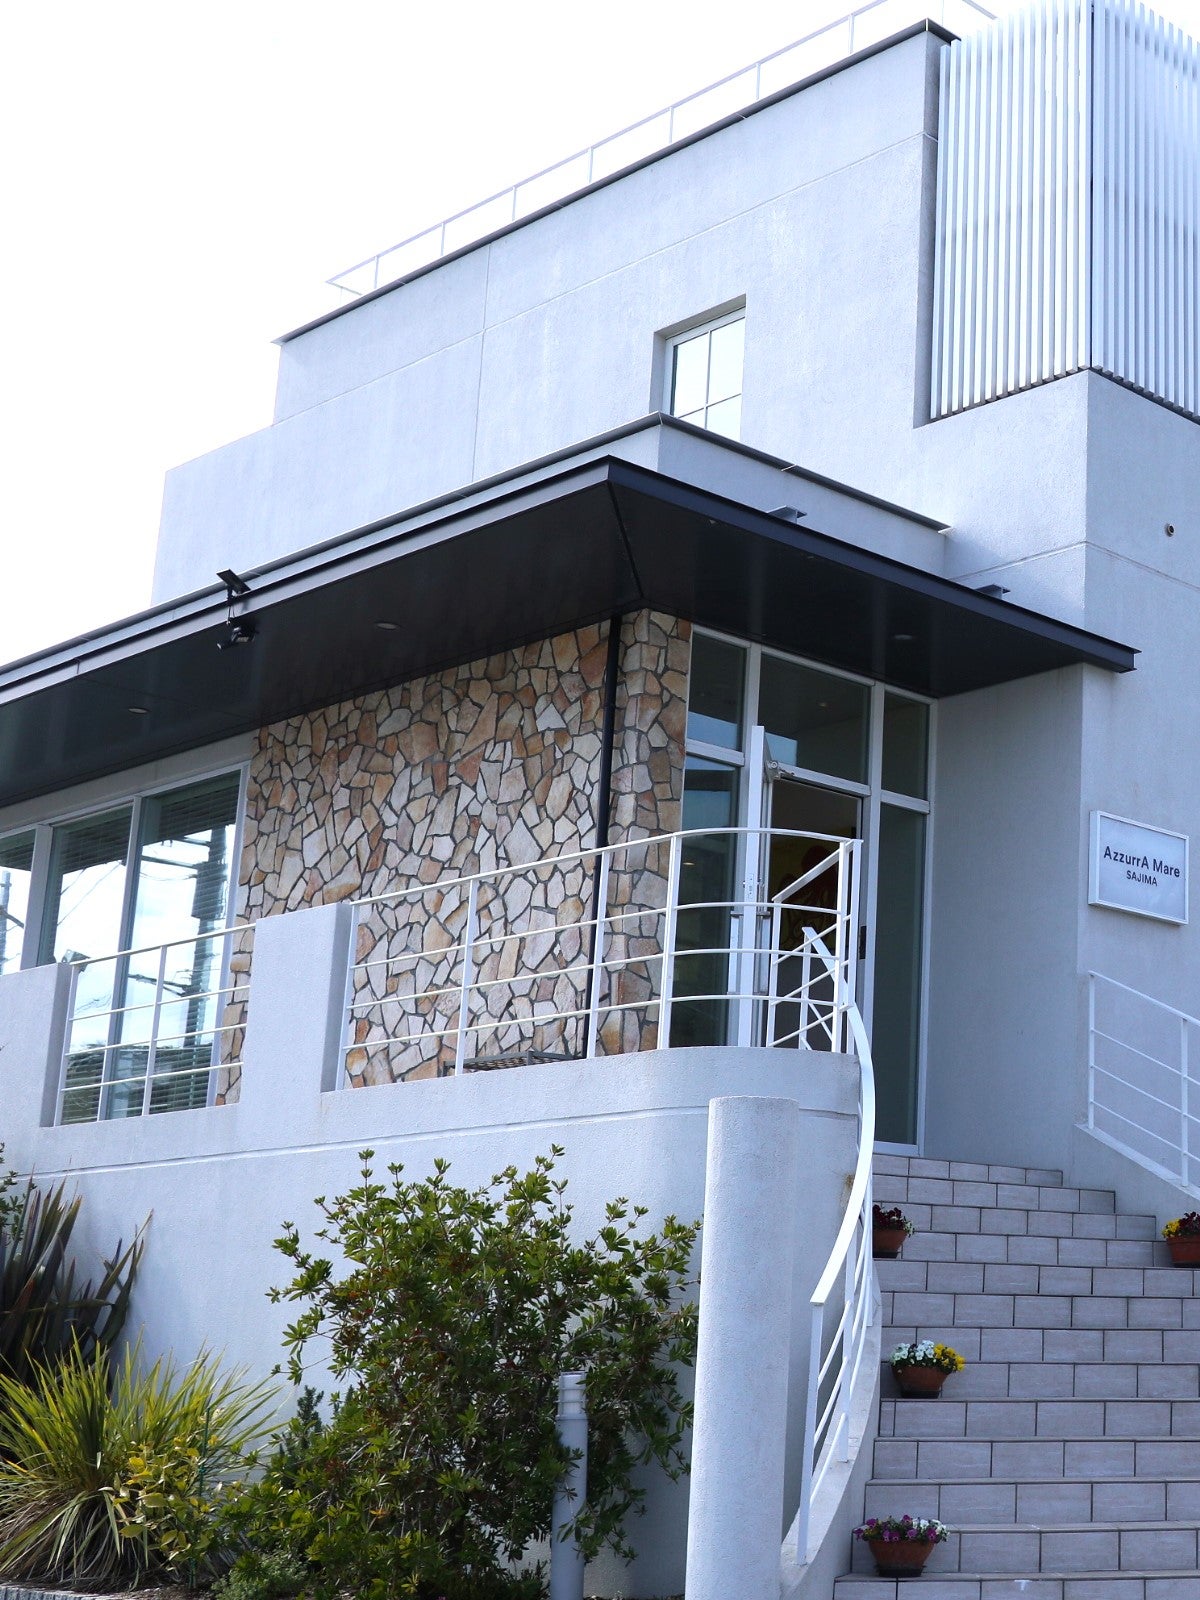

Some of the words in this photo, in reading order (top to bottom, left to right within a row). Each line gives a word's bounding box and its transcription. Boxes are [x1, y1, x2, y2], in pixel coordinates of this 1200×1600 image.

[1103, 845, 1149, 869] AzzurrA
[1153, 858, 1180, 878] Mare
[1126, 870, 1158, 887] SAJIMA
